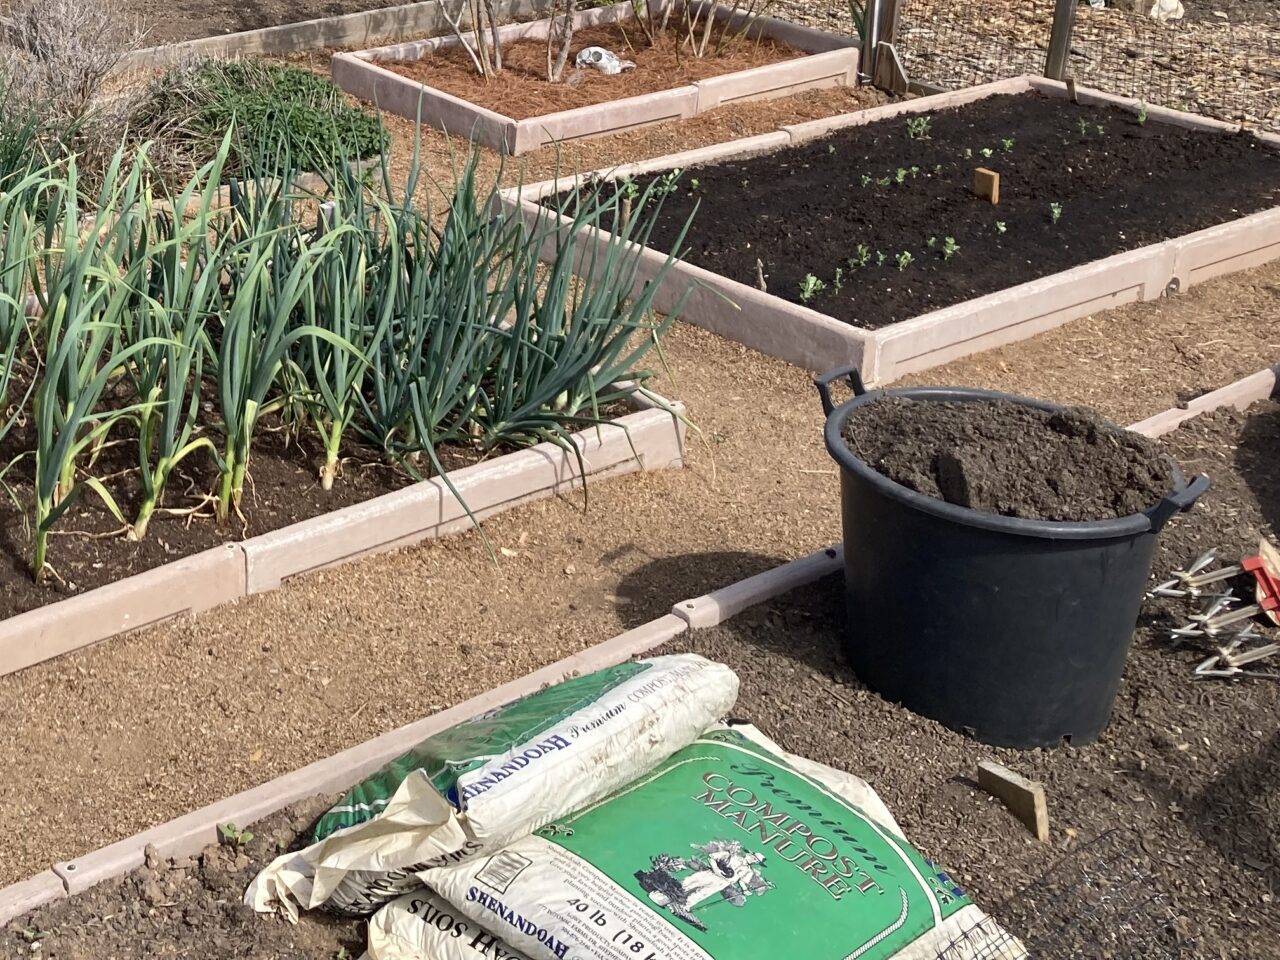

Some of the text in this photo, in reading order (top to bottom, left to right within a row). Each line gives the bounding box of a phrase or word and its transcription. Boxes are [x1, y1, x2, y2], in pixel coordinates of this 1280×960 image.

[462, 734, 572, 801] HENANDOAH
[691, 789, 852, 900] MANURE
[702, 772, 884, 896] COMPOST
[730, 763, 896, 877] Premium
[406, 897, 470, 940] SOILS
[466, 886, 570, 959] SHENANDOAH
[567, 898, 645, 953] 40 lb (18
[582, 923, 611, 946] PRODUCTS
[628, 922, 664, 953] Shenandoah
